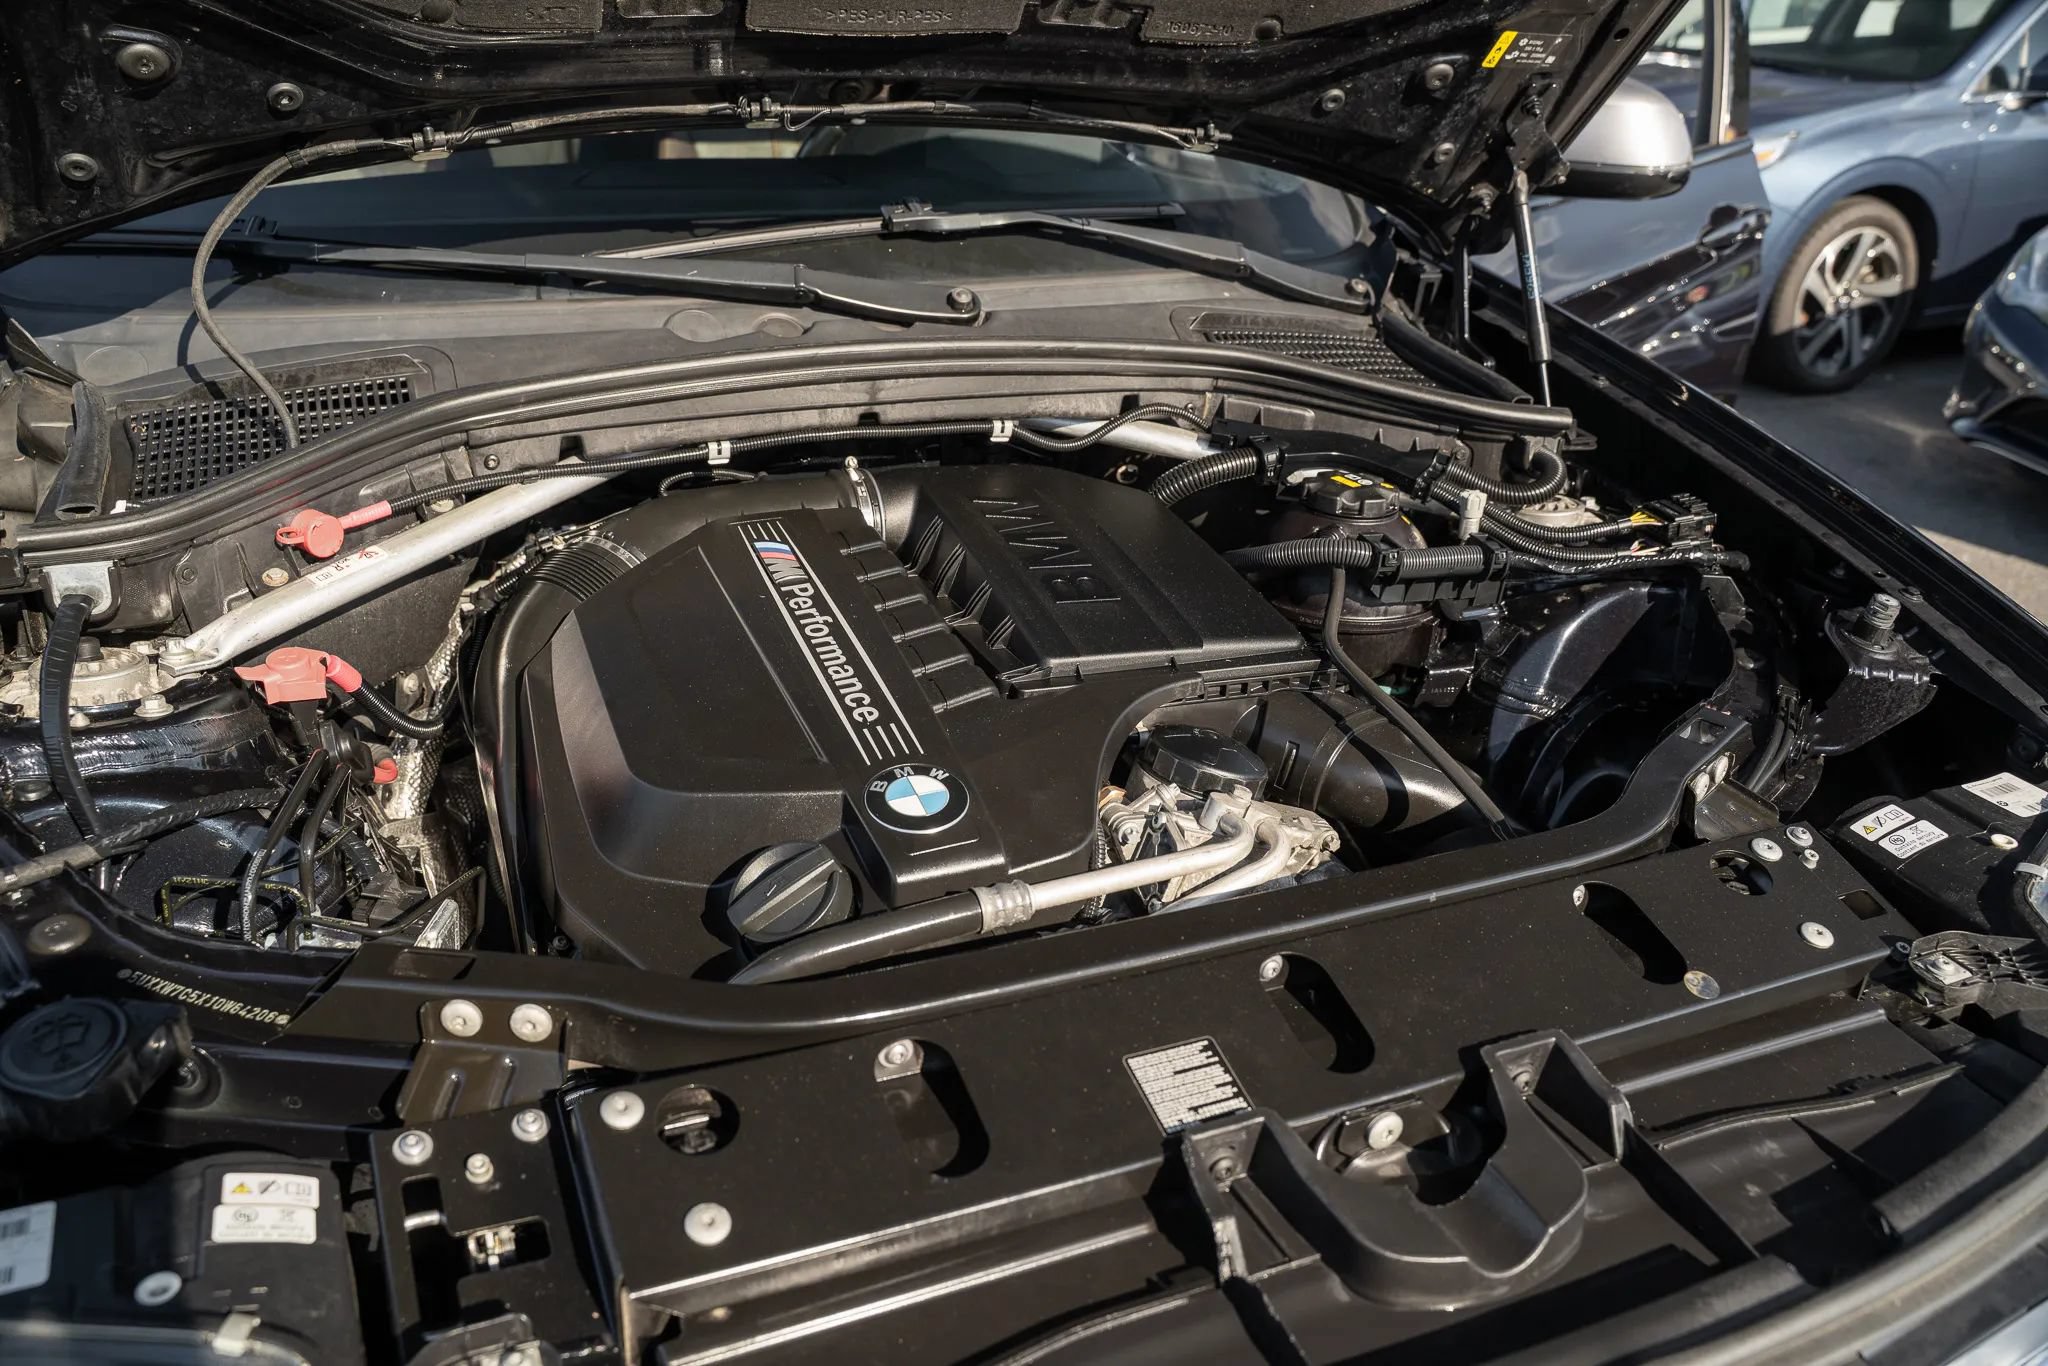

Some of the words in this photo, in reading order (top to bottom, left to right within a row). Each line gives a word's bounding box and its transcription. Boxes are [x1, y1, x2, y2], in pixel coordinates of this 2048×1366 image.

[972, 498, 1121, 605] BMW
[780, 581, 880, 723] Performance
[869, 766, 950, 793] BMW
